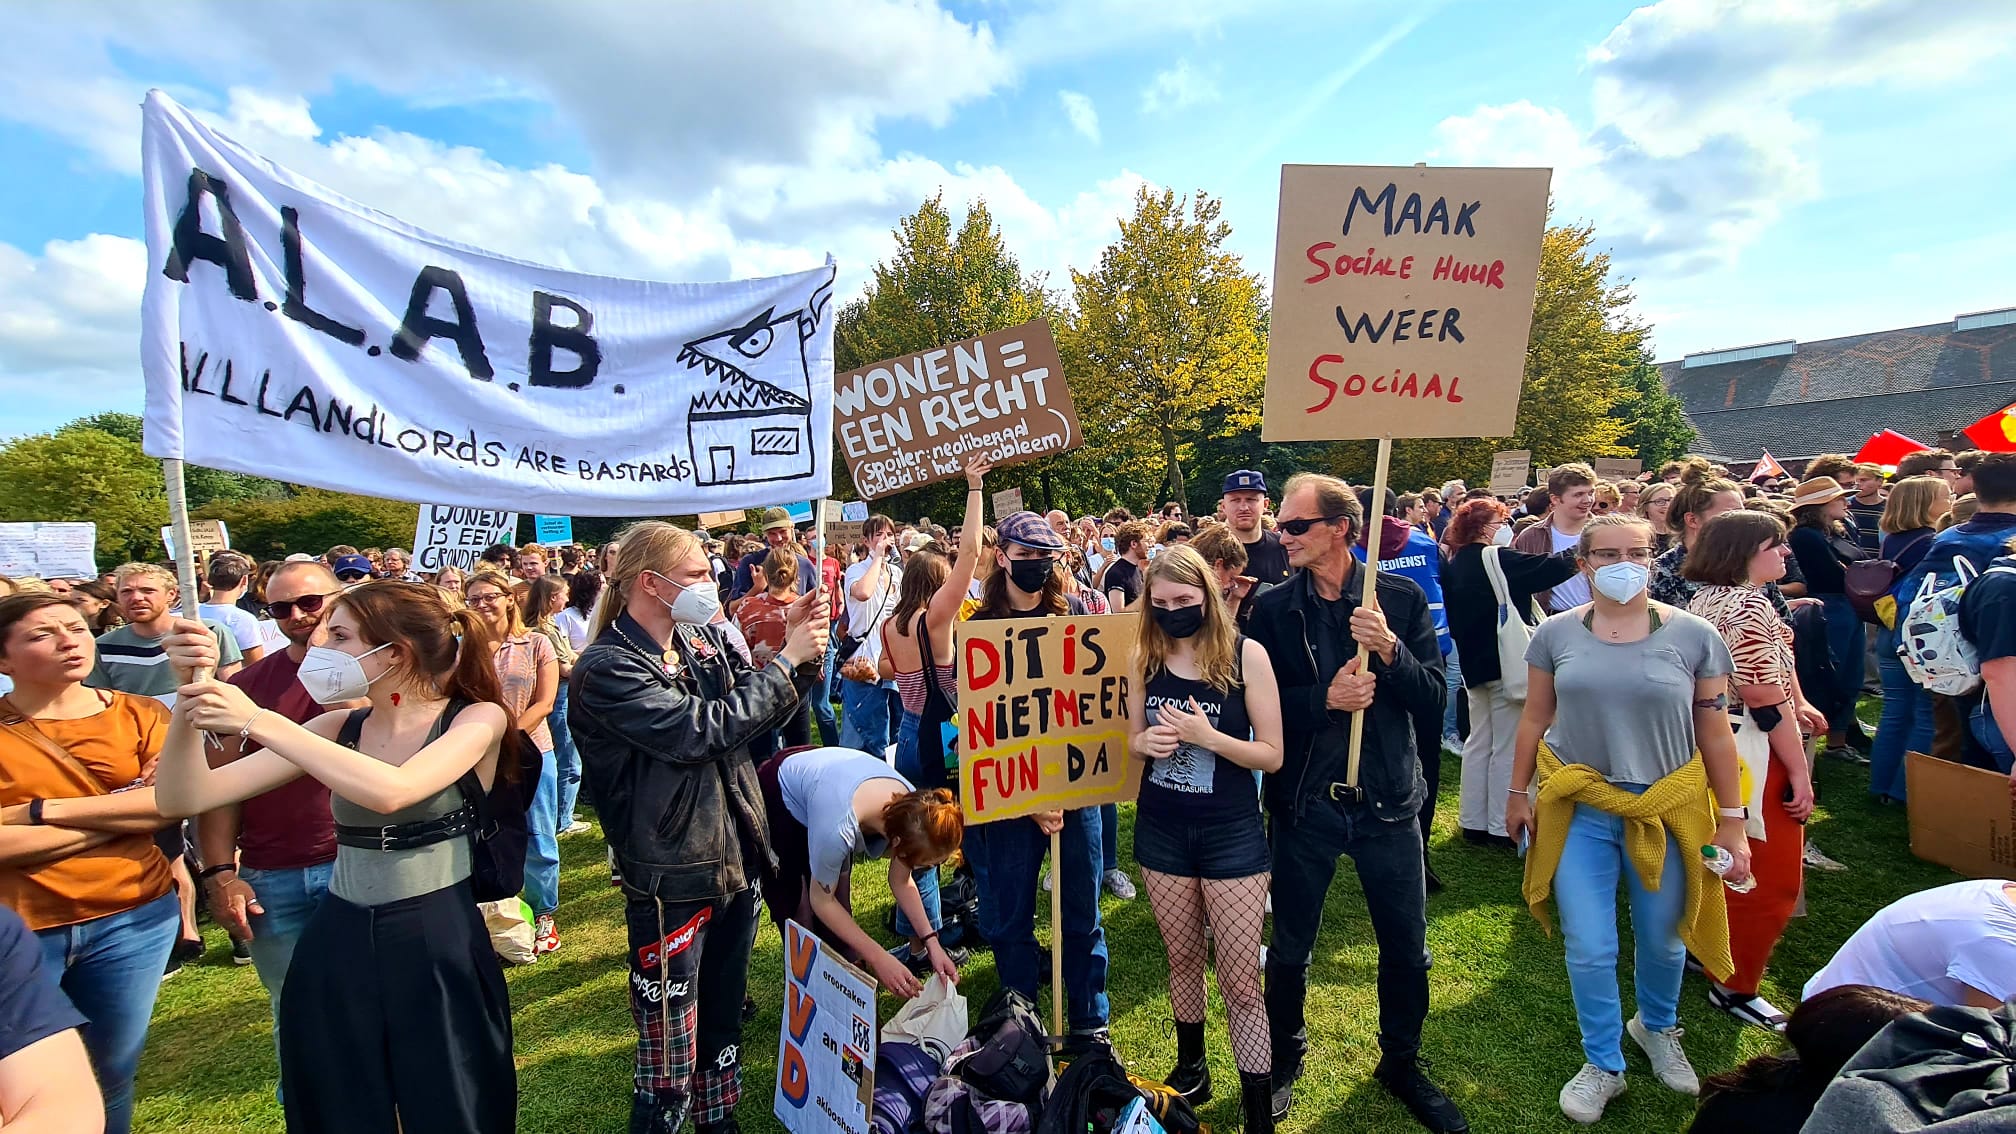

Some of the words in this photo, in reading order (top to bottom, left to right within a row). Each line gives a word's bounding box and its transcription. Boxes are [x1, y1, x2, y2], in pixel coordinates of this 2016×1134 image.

[1342, 183, 1481, 238] MAAK
[163, 167, 626, 396] A.L.A.B.
[1336, 305, 1465, 345] WEER
[834, 340, 990, 417] WONEN
[840, 406, 913, 459] EEN
[919, 367, 1049, 437] RECHT
[515, 446, 571, 474] ARE
[915, 466, 929, 481] is
[931, 456, 963, 476] het
[458, 527, 499, 546] EEN
[420, 546, 481, 572] GRONDR
[1376, 554, 1427, 571] DEDIENST
[1146, 695, 1165, 707] JOY
[972, 746, 1039, 812] FUN
[1174, 783, 1214, 794] PLEASURES
[852, 1017, 870, 1041] FCK
[822, 1031, 838, 1056] an
[853, 1033, 871, 1053] VVD
